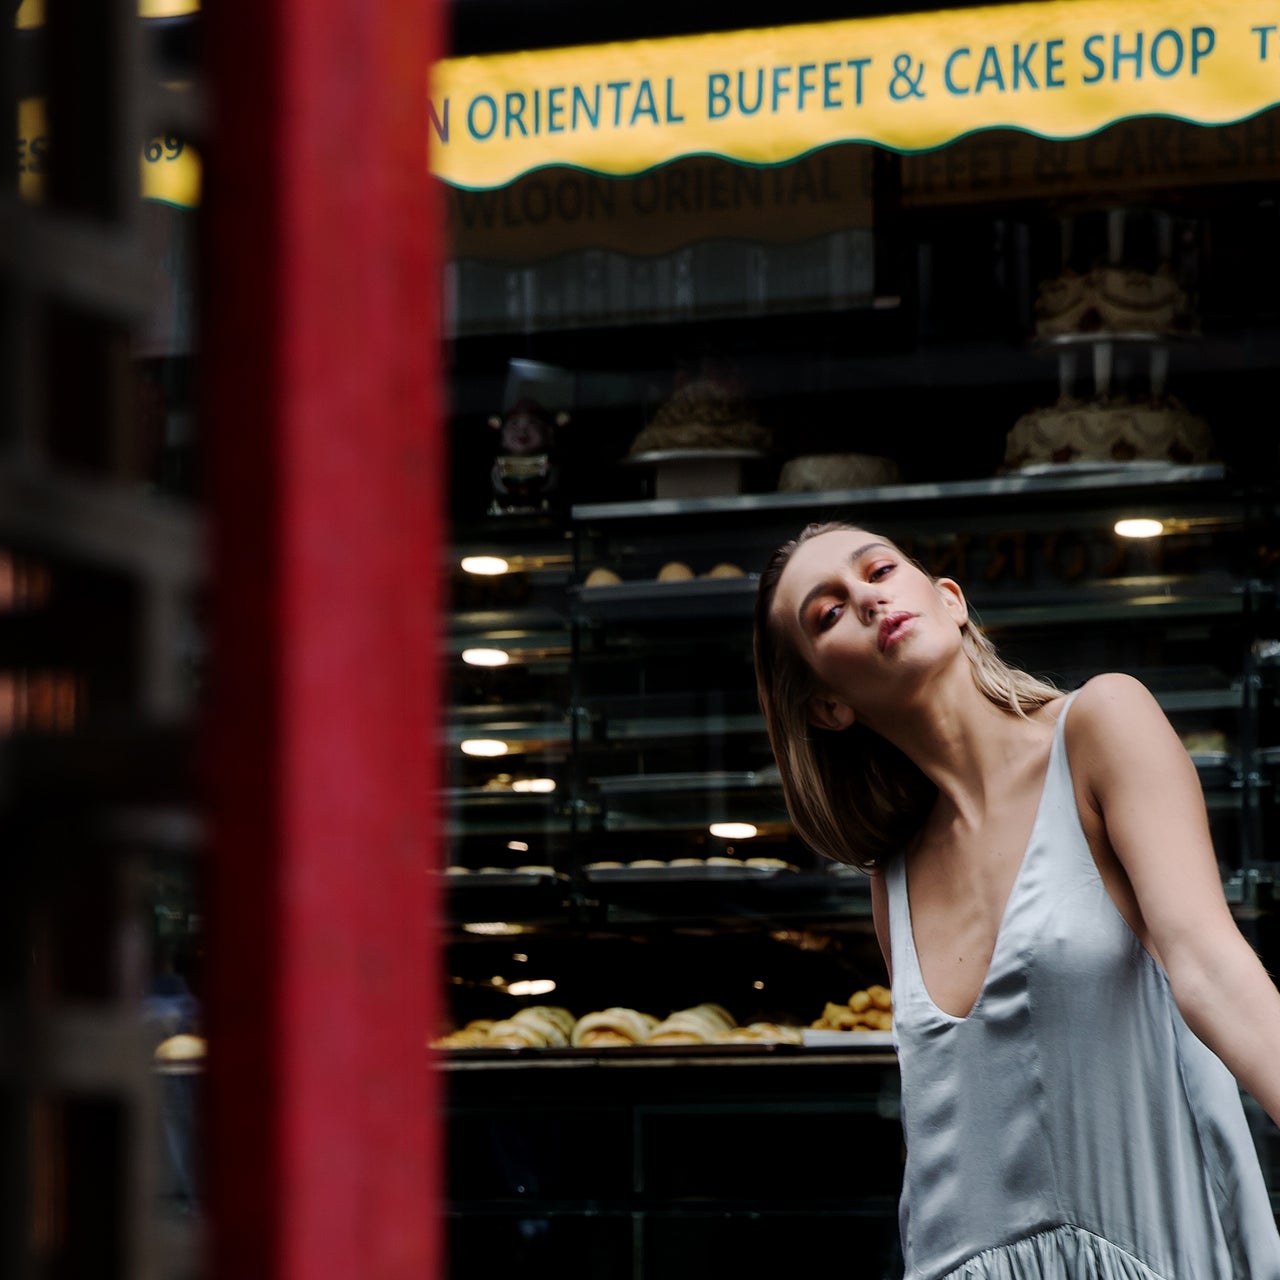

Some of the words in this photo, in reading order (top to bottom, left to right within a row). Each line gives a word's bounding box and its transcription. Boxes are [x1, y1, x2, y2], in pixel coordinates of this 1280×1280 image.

[466, 76, 685, 141] ORIENTAL
[708, 57, 873, 121] BUFFET
[888, 53, 926, 101] &
[943, 38, 1066, 96] CAKE
[1083, 26, 1216, 84] SHOP
